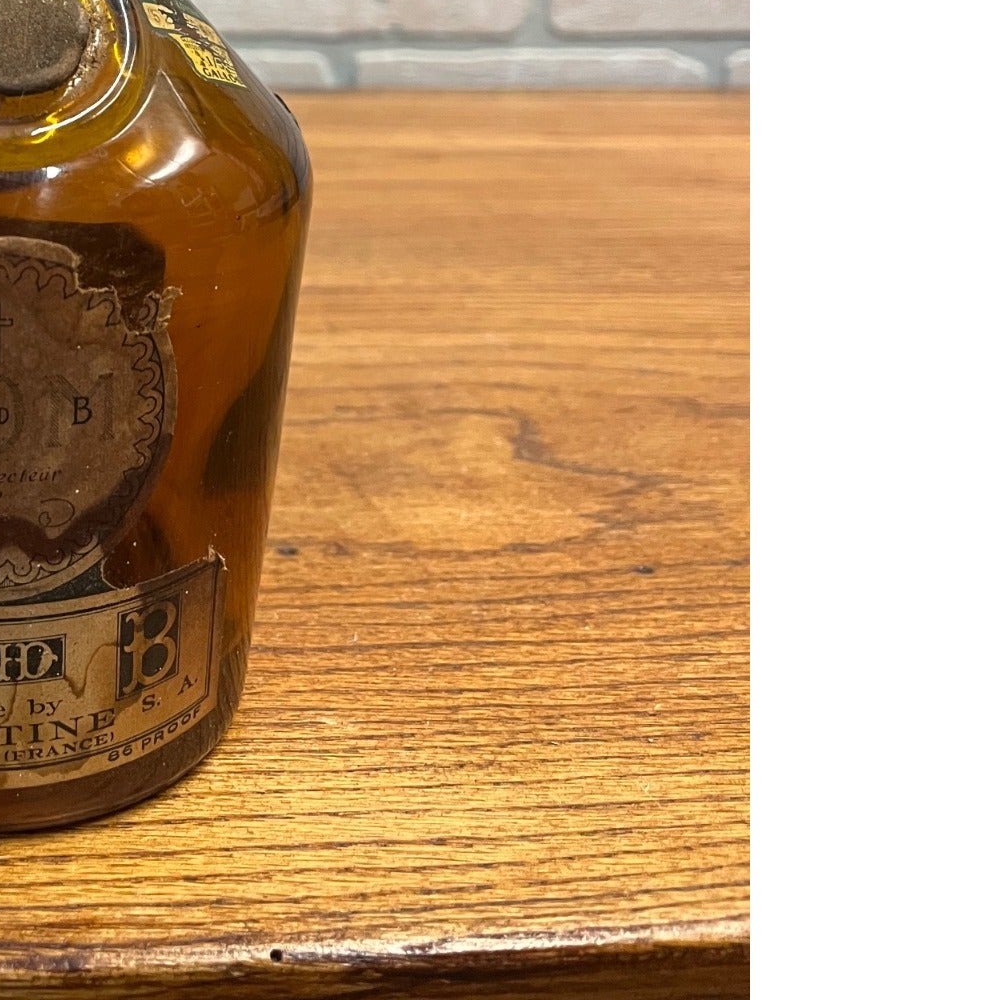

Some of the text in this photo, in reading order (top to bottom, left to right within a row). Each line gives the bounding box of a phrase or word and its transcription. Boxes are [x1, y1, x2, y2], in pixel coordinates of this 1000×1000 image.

[71, 395, 93, 425] B
[122, 602, 179, 694] B
[26, 698, 64, 717] by
[141, 693, 161, 713] S.
[177, 674, 198, 696] A.
[4, 731, 115, 763] (FRANCE)
[107, 744, 133, 762] 86
[141, 704, 202, 750] PROOF
